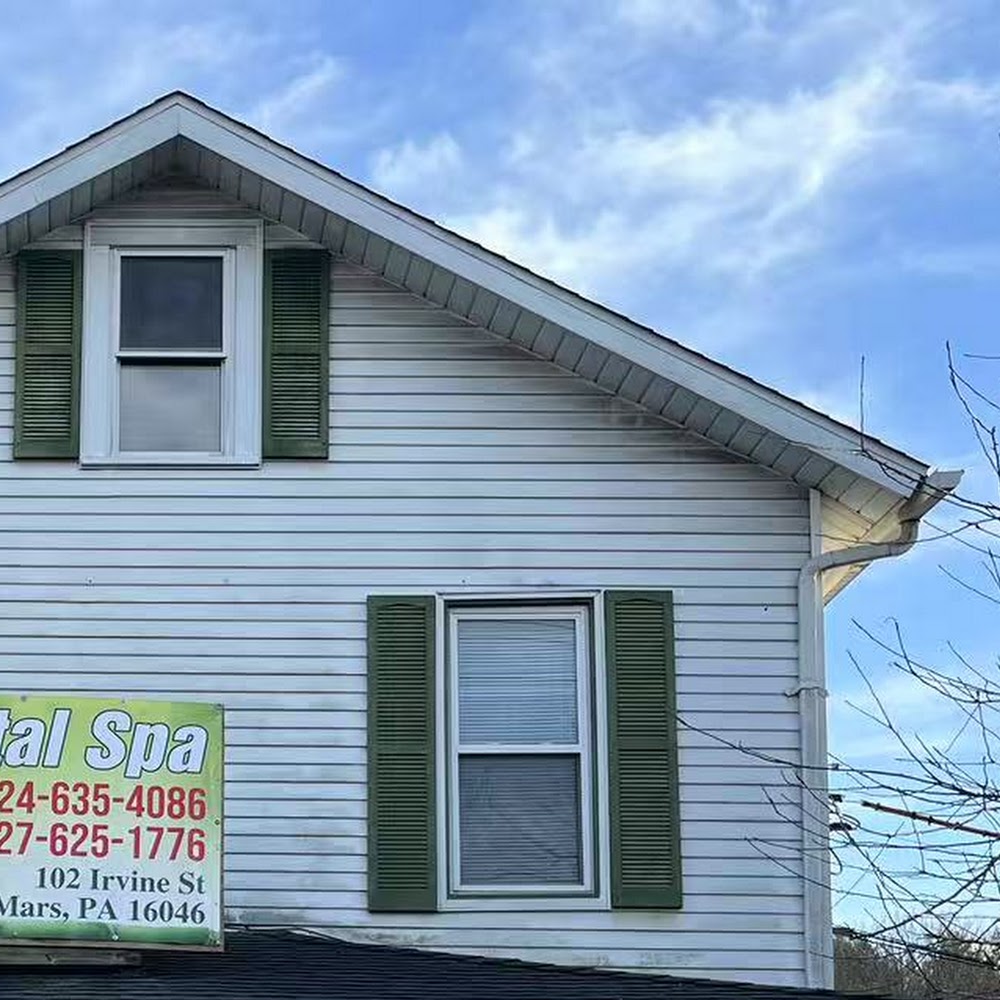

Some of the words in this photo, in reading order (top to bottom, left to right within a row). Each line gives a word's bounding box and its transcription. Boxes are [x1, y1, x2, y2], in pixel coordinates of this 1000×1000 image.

[84, 708, 210, 780] Spa
[35, 867, 80, 890] 102
[89, 868, 171, 893] Irvine
[178, 870, 207, 895] St
[78, 897, 118, 921] PA
[131, 900, 207, 925] 16046
